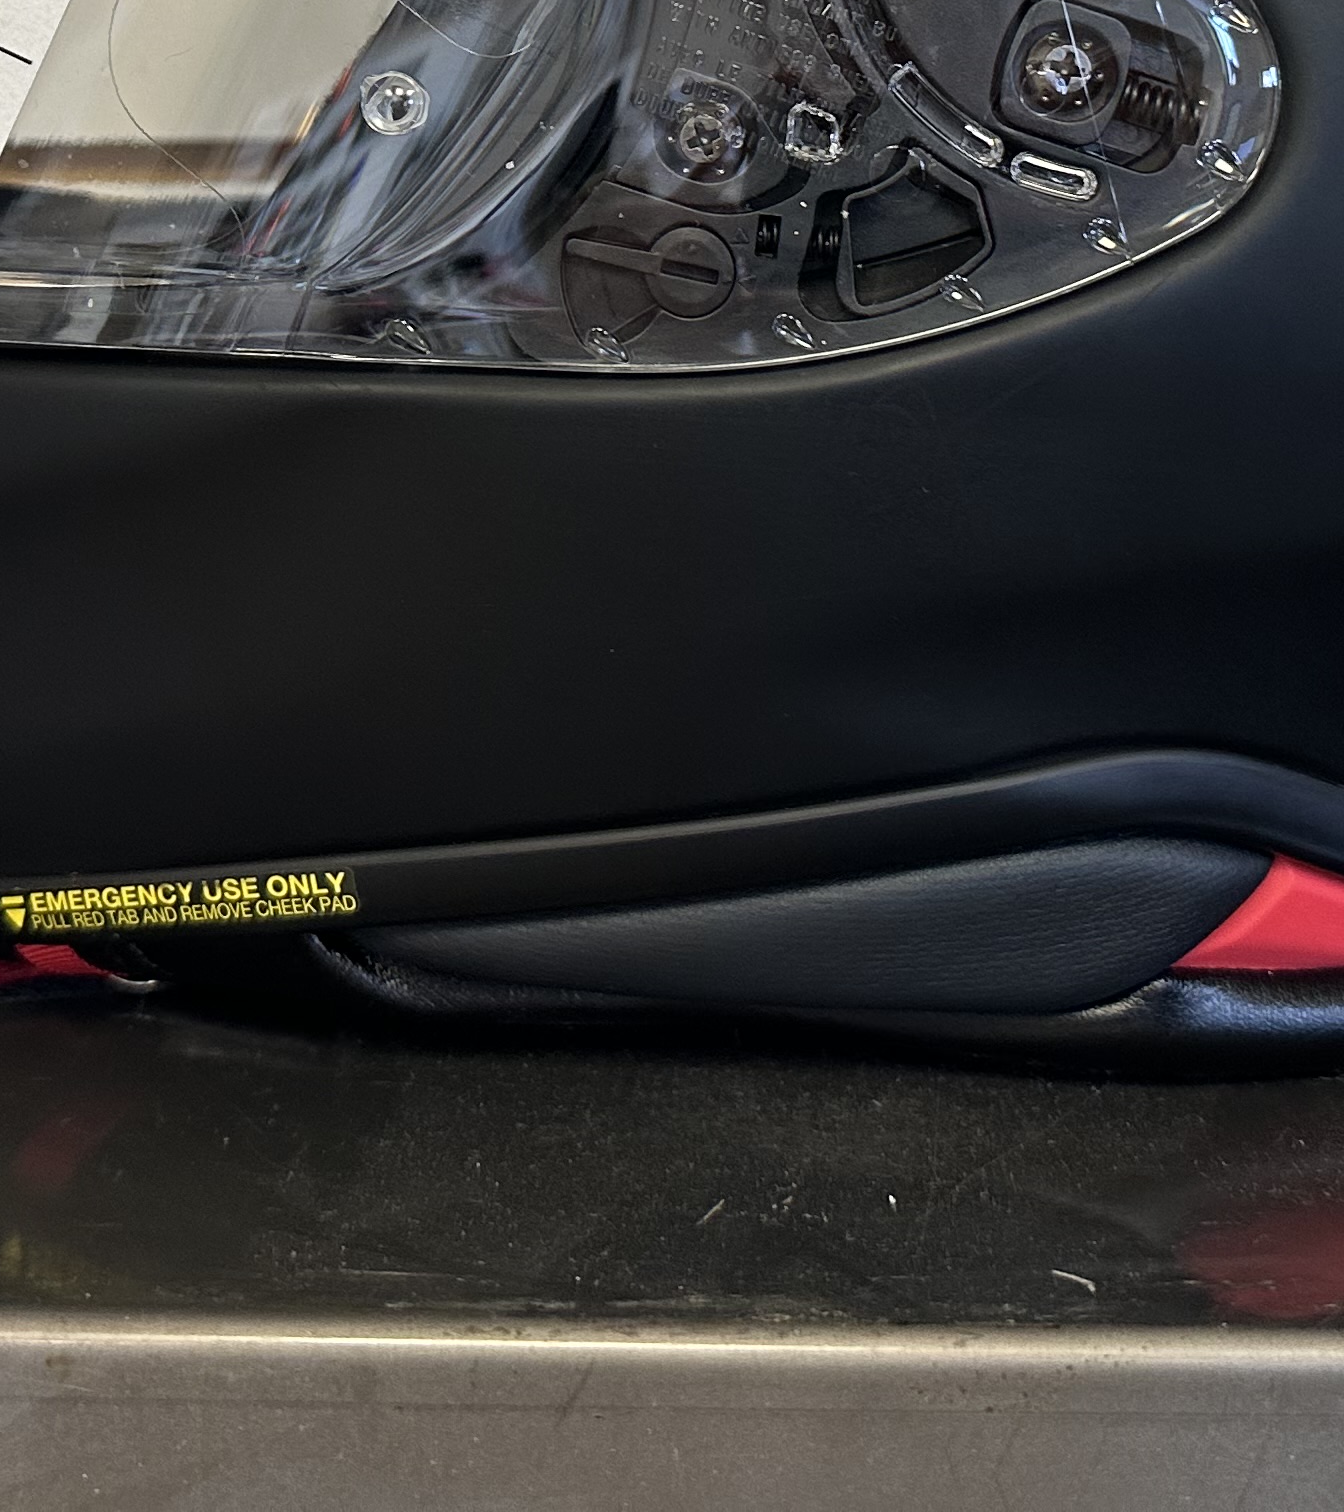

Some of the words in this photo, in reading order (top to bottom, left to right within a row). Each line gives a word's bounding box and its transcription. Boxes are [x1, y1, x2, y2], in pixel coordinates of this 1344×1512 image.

[30, 882, 193, 913] EMERGENCY
[201, 877, 260, 902] USE
[266, 871, 345, 898] ONLY
[31, 910, 71, 929] PULL
[74, 908, 105, 927] RED
[106, 907, 138, 925] TAB
[143, 905, 177, 923] AND
[181, 900, 253, 921] REMOVE
[256, 898, 317, 917] CHEEK
[320, 894, 356, 913] PAD
